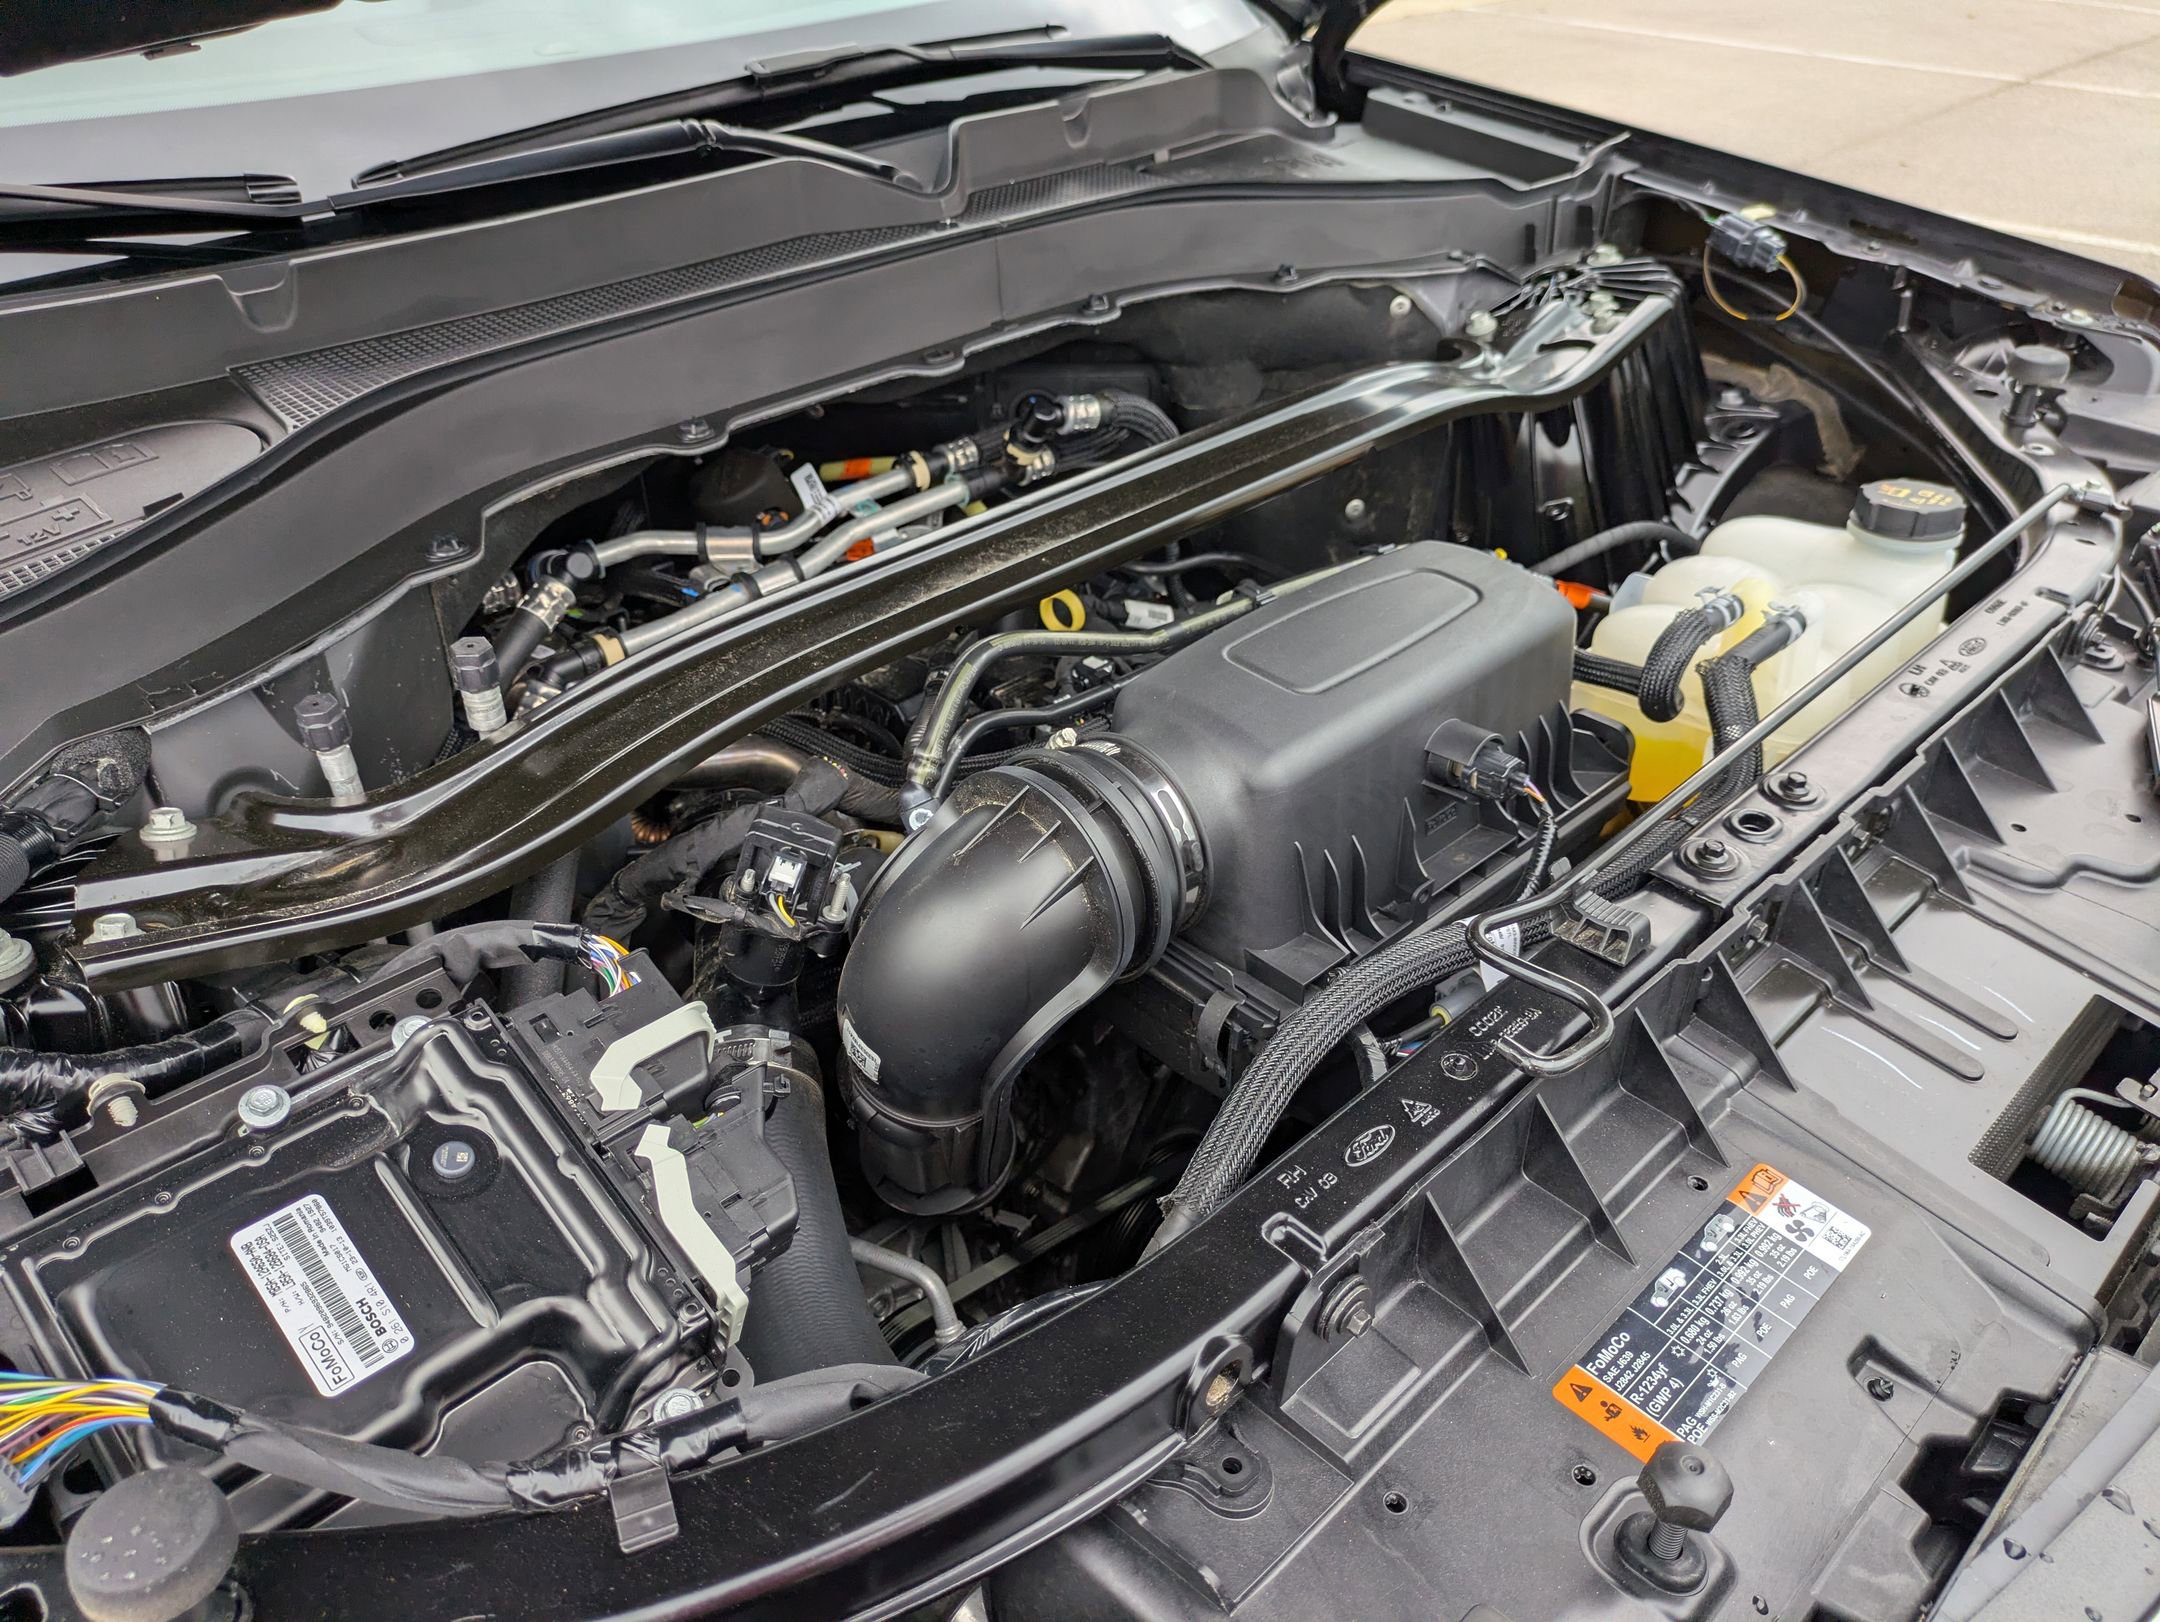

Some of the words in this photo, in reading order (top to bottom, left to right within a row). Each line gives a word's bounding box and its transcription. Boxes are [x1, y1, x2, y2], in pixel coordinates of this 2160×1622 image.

[17, 523, 61, 545] 12V
[1276, 1164, 1307, 1189] RH
[295, 1206, 315, 1233] Romania
[1742, 1217, 1758, 1233] FHEV
[1749, 1222, 1765, 1238] PHEV
[275, 1242, 291, 1261] SITE:
[316, 1239, 330, 1257] Made
[335, 1235, 358, 1265] 23-10-13
[1754, 1238, 1774, 1257] 0.992
[1766, 1232, 1782, 1242] kg
[1769, 1249, 1780, 1259] 35
[1776, 1243, 1786, 1252] oz
[1776, 1254, 1791, 1268] 2.19
[1784, 1247, 1797, 1257] lbs
[1730, 1265, 1750, 1284] 0.992
[1743, 1258, 1759, 1269] kg
[1745, 1275, 1756, 1285] 35
[1752, 1270, 1762, 1279] oz
[1761, 1274, 1774, 1284] lbs
[1803, 1265, 1818, 1280] POE
[292, 1290, 304, 1305] H/W:
[1691, 1293, 1706, 1305] 3.3L
[1700, 1278, 1717, 1295] FHEV
[1704, 1295, 1724, 1315] 0.737
[1718, 1288, 1735, 1299] kg
[1779, 1293, 1795, 1309] PAG
[278, 1297, 291, 1313] P/N:
[1720, 1306, 1732, 1317] 26
[1728, 1300, 1737, 1309] oz
[1727, 1311, 1742, 1325] 1.63
[1736, 1304, 1749, 1316] lbs
[355, 1297, 387, 1337] BOSCH
[388, 1318, 403, 1334] 261
[1666, 1322, 1680, 1335] 3.0L
[1680, 1306, 1694, 1319] 3.3L
[331, 1329, 344, 1345] S/N:
[1679, 1324, 1700, 1344] 0.680
[1693, 1316, 1710, 1327] kg
[1695, 1335, 1707, 1346] 24
[1703, 1328, 1713, 1338] oz
[1755, 1322, 1772, 1338] POE
[1585, 1332, 1630, 1375] FoMoCo
[1703, 1340, 1718, 1354] 1.50
[1712, 1331, 1727, 1344] lbs
[309, 1331, 347, 1385] FoMoCo
[1602, 1365, 1620, 1383] SAE
[1616, 1350, 1634, 1368] J639
[1731, 1352, 1747, 1368] PAG
[1614, 1369, 1635, 1391] J2842
[1631, 1350, 1651, 1373] J2845
[1629, 1361, 1669, 1404] R-1234yf
[1645, 1386, 1671, 1417] (GWP
[1668, 1376, 1684, 1389] 4)
[1676, 1416, 1697, 1438] PAG
[1686, 1422, 1709, 1445] POE
